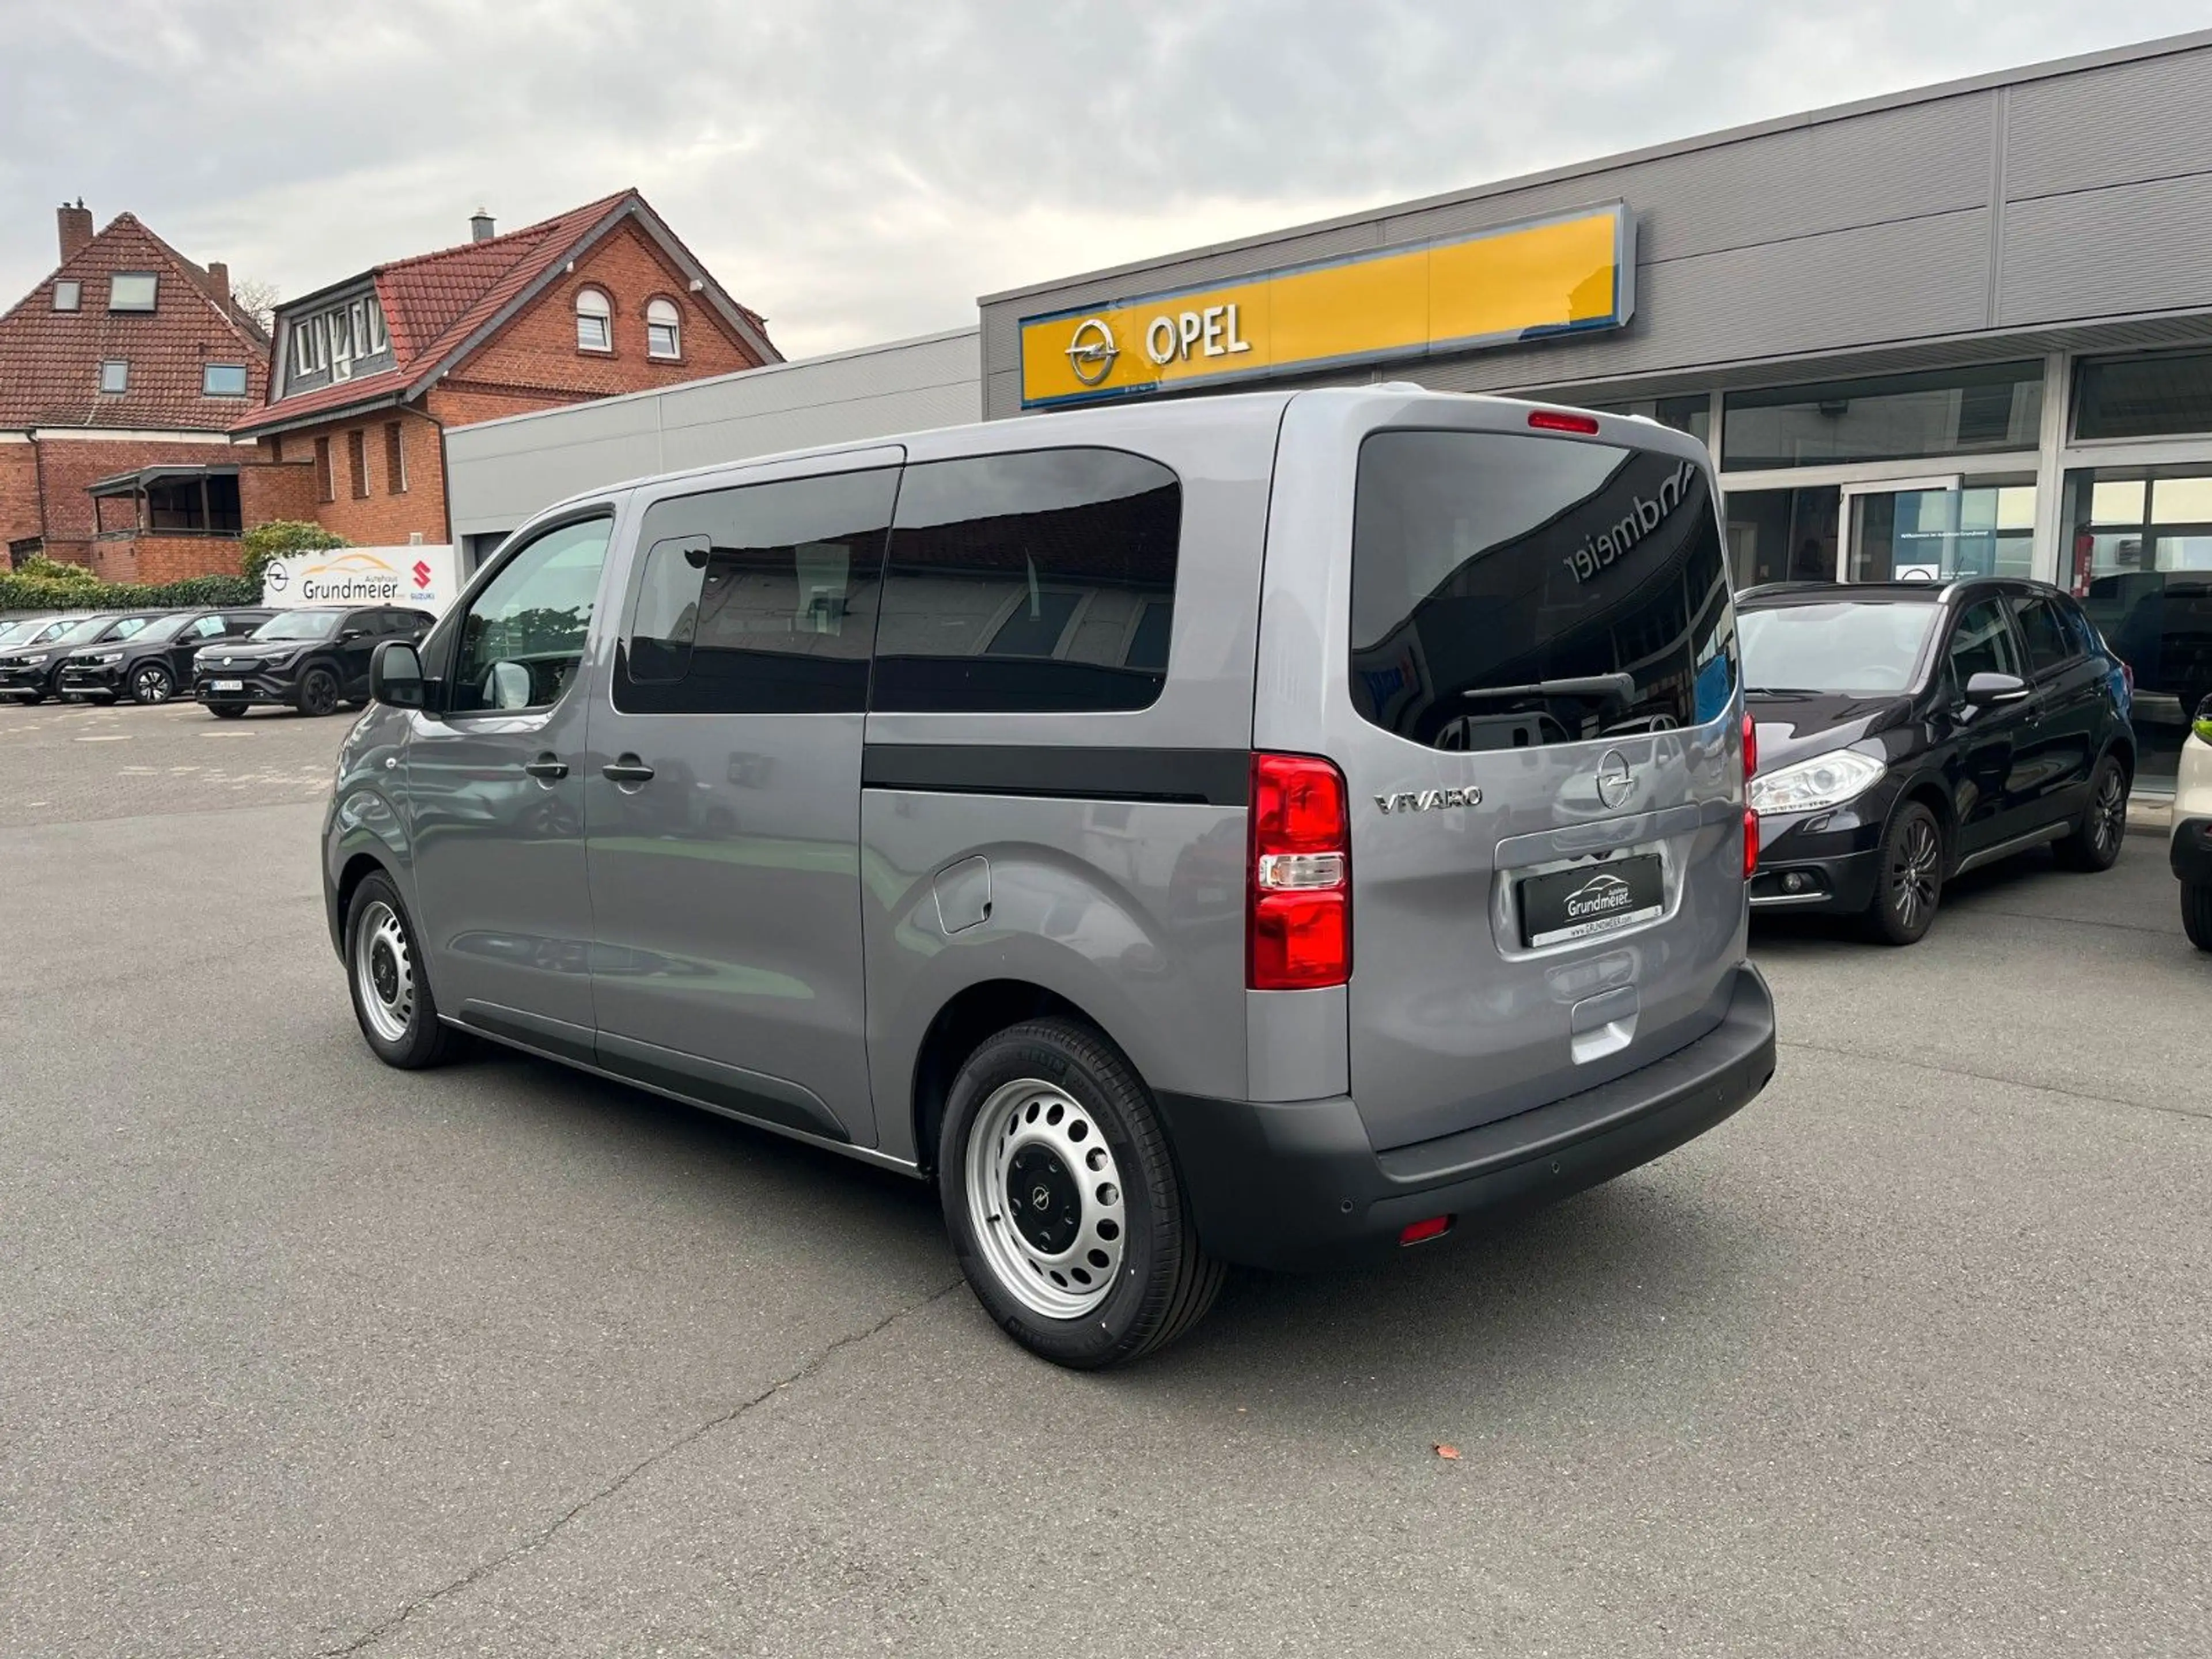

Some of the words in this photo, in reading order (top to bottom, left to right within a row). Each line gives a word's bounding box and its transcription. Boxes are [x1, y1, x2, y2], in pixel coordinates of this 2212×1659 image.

[1146, 304, 1251, 365] OPEL
[303, 578, 399, 599] Grundmeier
[410, 592, 435, 600] SUZUKI
[1374, 785, 1483, 815] VIVARO
[1567, 893, 1628, 916] Grundmeier
